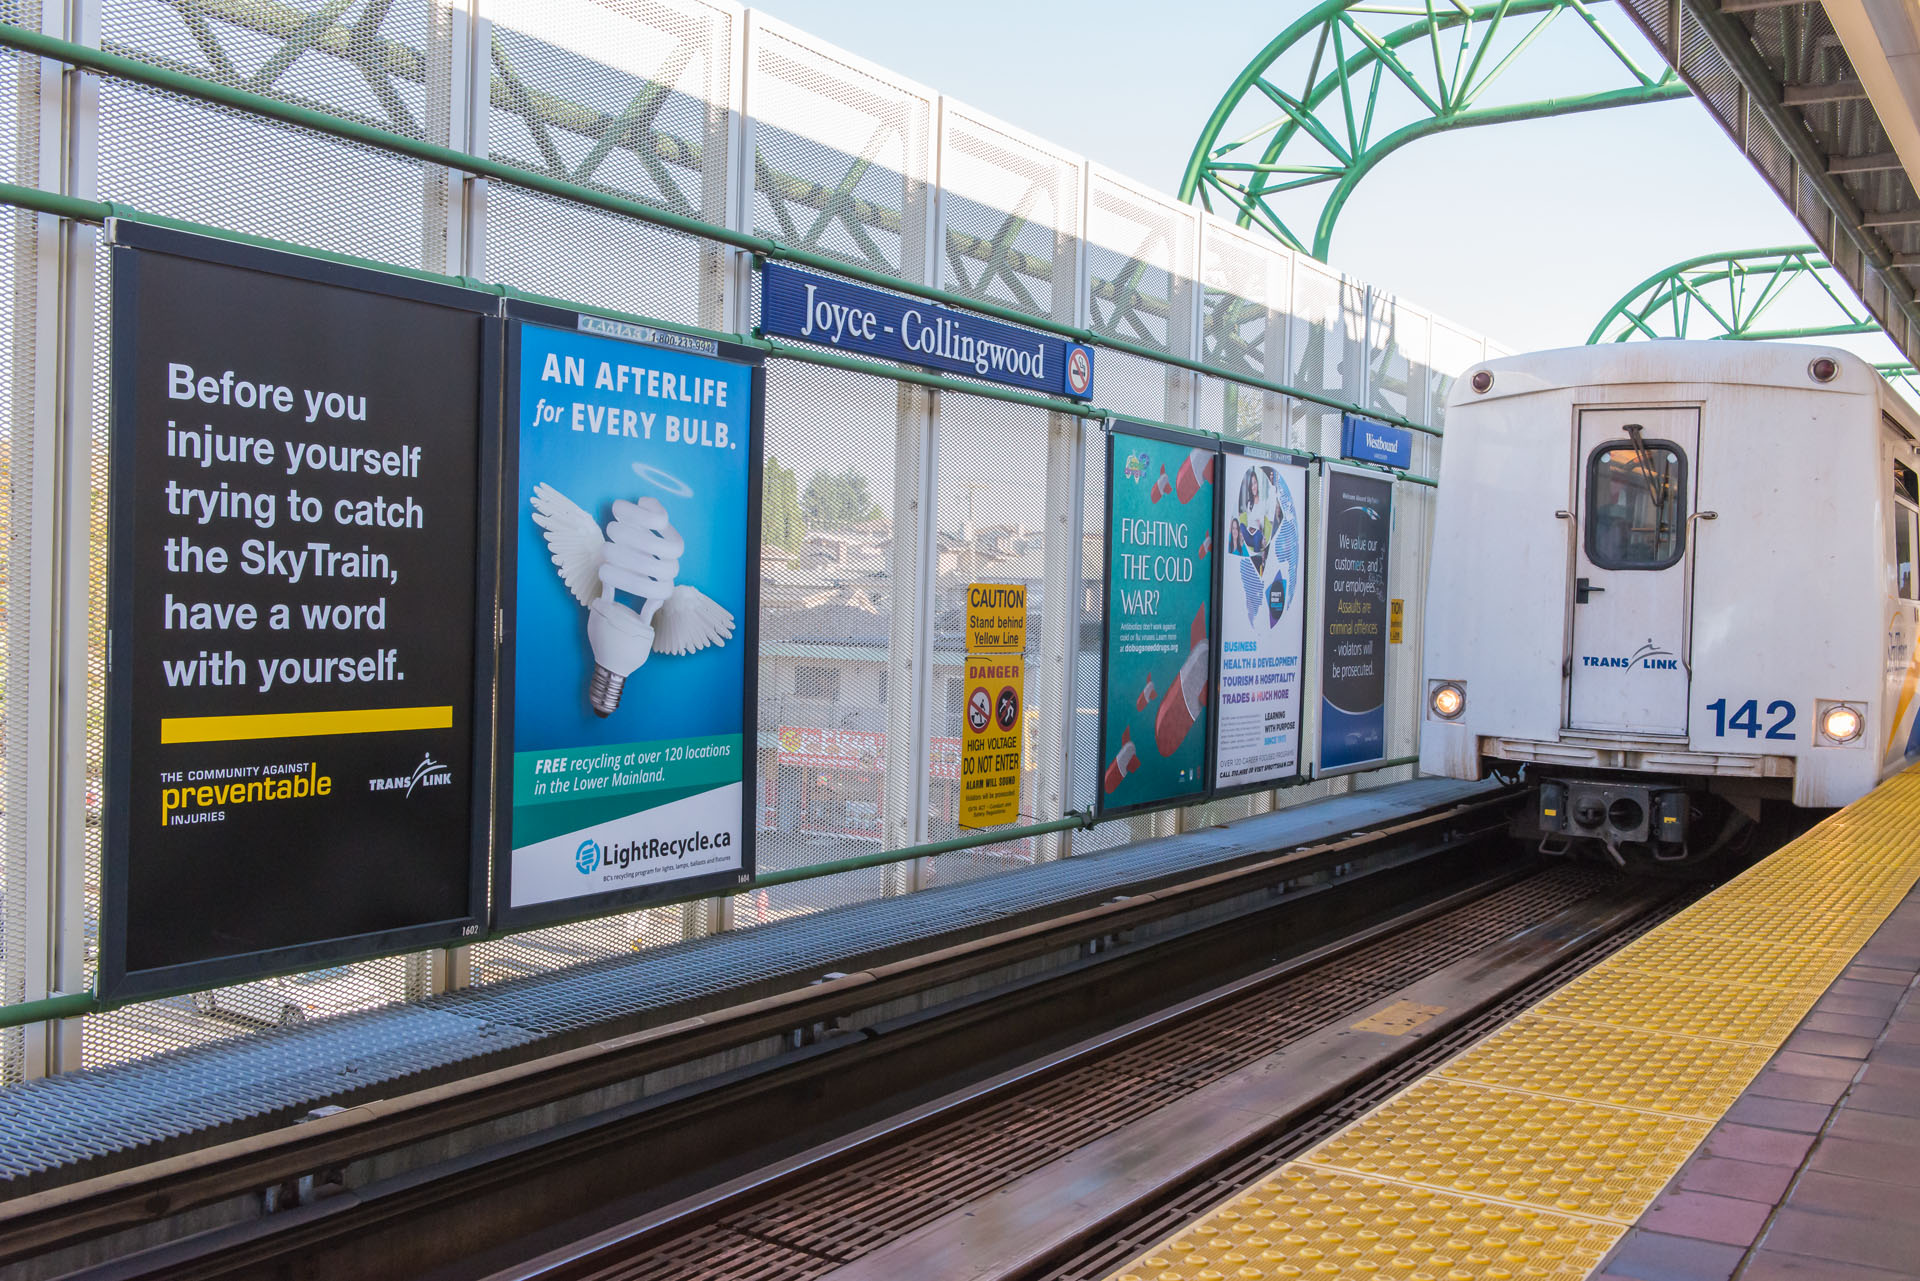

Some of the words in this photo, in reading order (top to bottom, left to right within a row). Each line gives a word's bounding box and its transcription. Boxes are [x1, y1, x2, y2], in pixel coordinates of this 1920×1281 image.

[801, 283, 876, 343] Joyce
[884, 325, 894, 333] -
[901, 310, 1045, 379] Collingwood
[541, 353, 585, 387] AN
[595, 362, 728, 408] AFTERLIFE
[168, 363, 293, 412] Before
[304, 389, 366, 423] you
[532, 398, 564, 427] for
[572, 402, 657, 440] EVERY
[665, 415, 736, 450] BULB.
[167, 420, 274, 468] injure
[285, 441, 421, 478] yourself
[1366, 433, 1398, 453] Westbound
[165, 480, 275, 528] trying
[288, 489, 322, 523] to
[334, 496, 424, 529] catch
[1121, 517, 1188, 549] FIGHTING
[1339, 533, 1350, 549] We
[1350, 536, 1366, 550] value
[1367, 540, 1378, 551] our
[164, 537, 228, 573] the
[240, 539, 398, 584] SkyTrain,
[1120, 553, 1150, 581] THE
[1154, 555, 1193, 582] COLD
[1334, 557, 1366, 573] customers,
[1367, 558, 1378, 573] and
[1333, 580, 1345, 592] our
[971, 588, 1024, 608] CAUTION
[1120, 589, 1160, 615] WAR?
[1337, 599, 1361, 614] Assaults
[1361, 602, 1372, 614] are
[164, 593, 258, 630] have
[269, 603, 290, 630] a
[301, 597, 386, 630] word
[970, 615, 994, 628] Stand
[998, 616, 1023, 628] behind
[1329, 619, 1353, 635] criminal
[1353, 619, 1378, 635] offences
[974, 632, 1000, 645] Yellow
[1002, 632, 1019, 644] Line
[1224, 641, 1257, 652] BUSINESS
[1337, 640, 1362, 656] violators
[1363, 640, 1373, 656] will
[163, 650, 246, 687] with
[258, 648, 404, 693] yourself.
[969, 665, 1020, 679] DANGER
[1223, 658, 1251, 670] HEALTH
[1258, 656, 1298, 668] DEVELOPMENT
[1332, 662, 1341, 678] be
[1341, 659, 1374, 680] prosecuted.
[1222, 674, 1254, 687] TOURISM
[1260, 672, 1296, 685] HOSPITALITY
[1222, 692, 1250, 705] TRADES
[1256, 690, 1272, 702] MUCH
[1273, 689, 1289, 701] MORE
[1264, 711, 1286, 721] LEARNING
[1706, 698, 1796, 741] 142
[1264, 724, 1276, 733] WITH
[1276, 721, 1296, 731] PURPOSE
[967, 739, 985, 752] HIGH
[987, 736, 1017, 750] VOLTAGE
[534, 757, 568, 775] FREE
[570, 752, 621, 774] recycling
[623, 752, 635, 767] at
[638, 751, 661, 765] over
[665, 747, 683, 762] 120
[685, 743, 731, 760] locations
[963, 757, 975, 775] DO
[977, 755, 993, 773] NOT
[995, 753, 1019, 772] ENTER
[1220, 759, 1233, 768] OVER
[160, 772, 183, 783] THE
[188, 766, 260, 781] COMMUNITY
[262, 762, 309, 776] AGAINST
[534, 780, 547, 796] in
[549, 777, 570, 794] the
[573, 773, 609, 791] Lower
[611, 767, 665, 788] Mainland.
[1219, 771, 1231, 779] CALL
[1254, 765, 1264, 773] VISIT
[966, 779, 984, 790] ALARM
[985, 778, 997, 788] WILL
[999, 776, 1016, 786] SOUND
[162, 762, 332, 826] preventable
[171, 811, 226, 826] INJURIES
[603, 831, 731, 869] LightRecycle.ca
[462, 925, 478, 937] 1602
